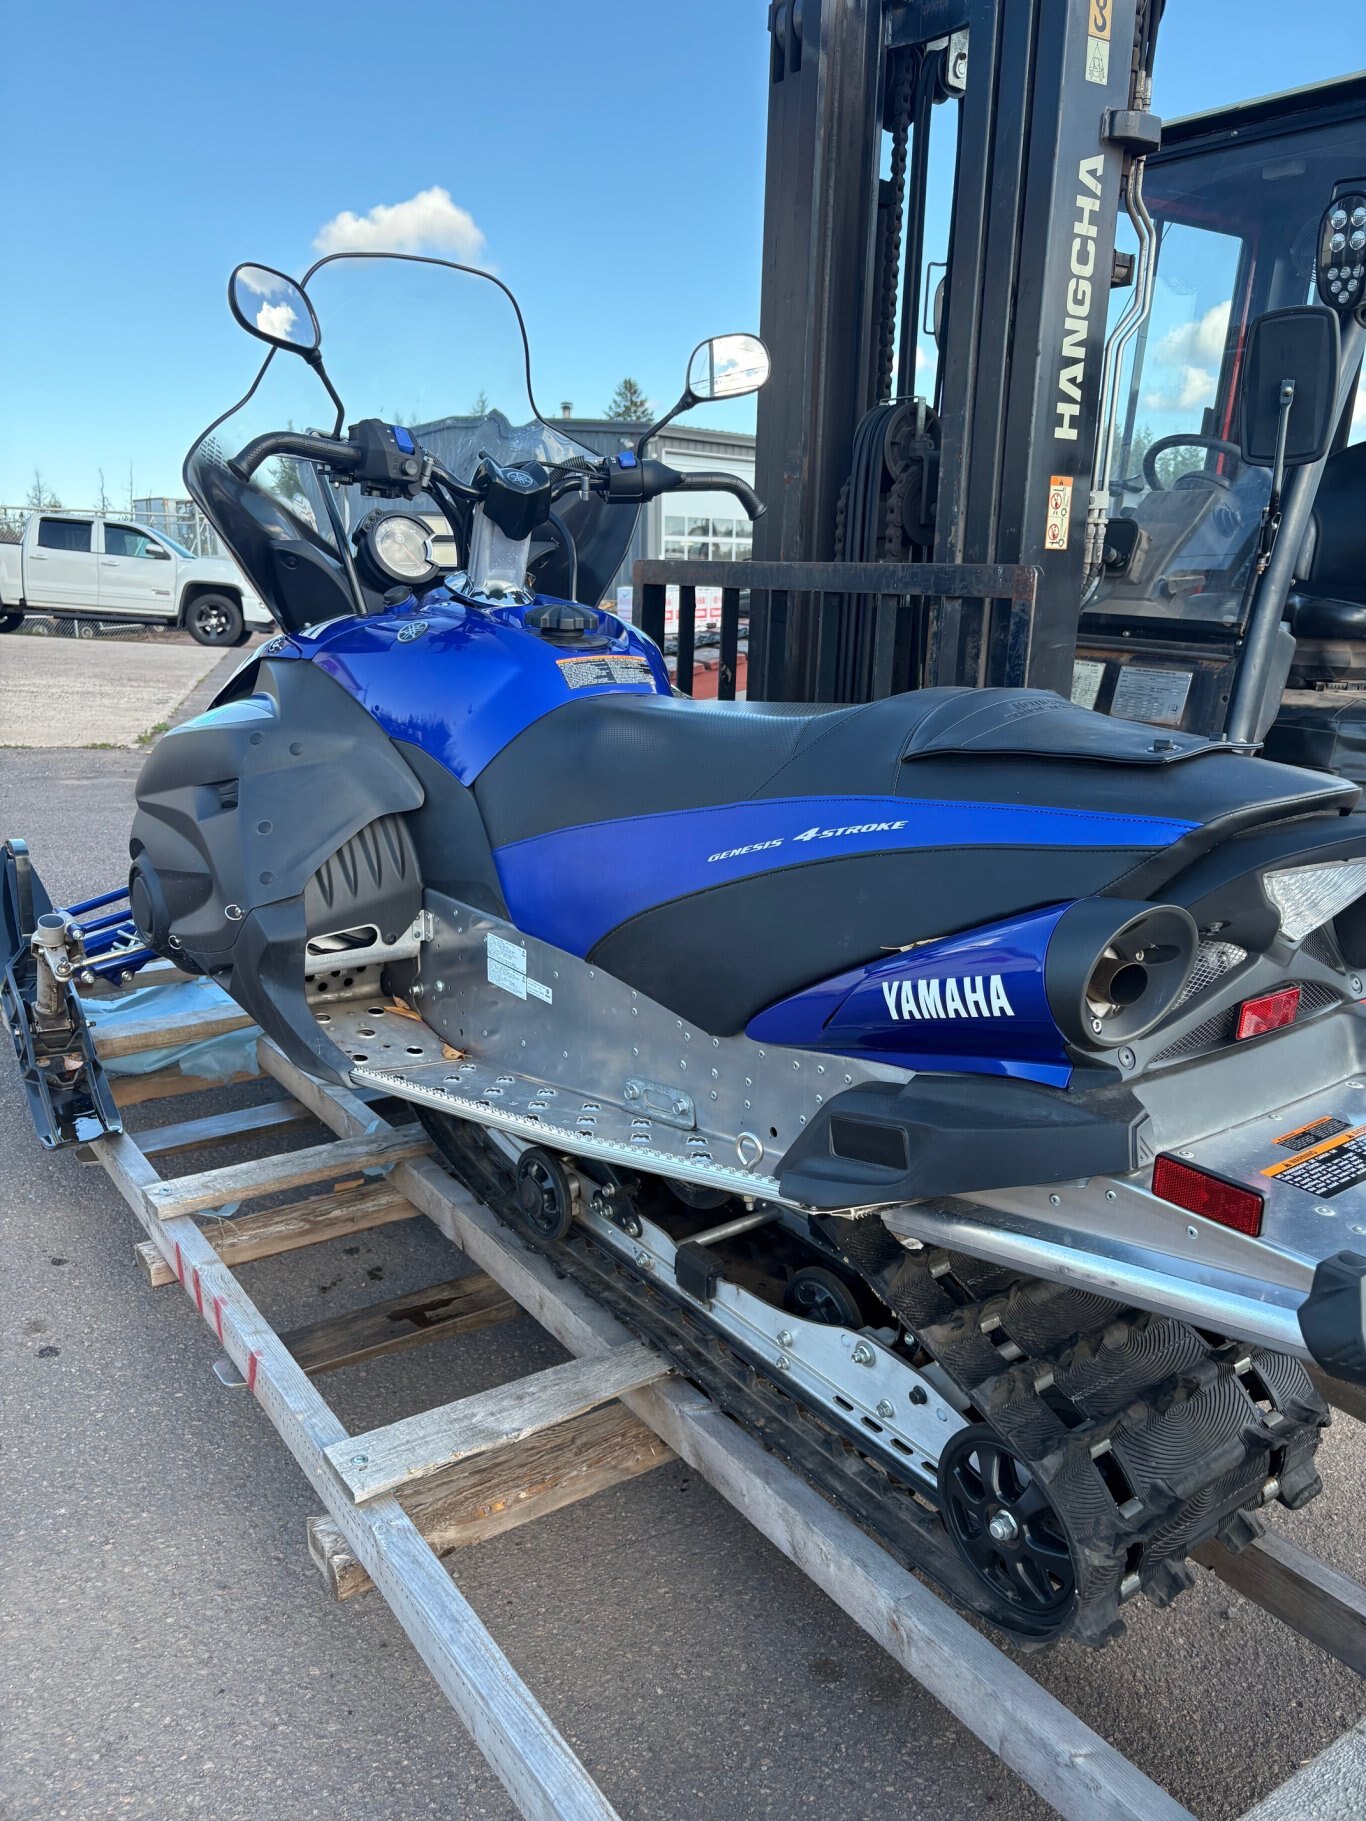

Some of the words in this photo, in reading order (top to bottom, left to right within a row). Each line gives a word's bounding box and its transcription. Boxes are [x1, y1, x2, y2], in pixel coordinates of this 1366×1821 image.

[1054, 154, 1104, 440] HANGCHA
[707, 838, 784, 863] GENESIS
[792, 820, 909, 842] 4-STROKE
[882, 974, 1015, 1020] YAMAHA
